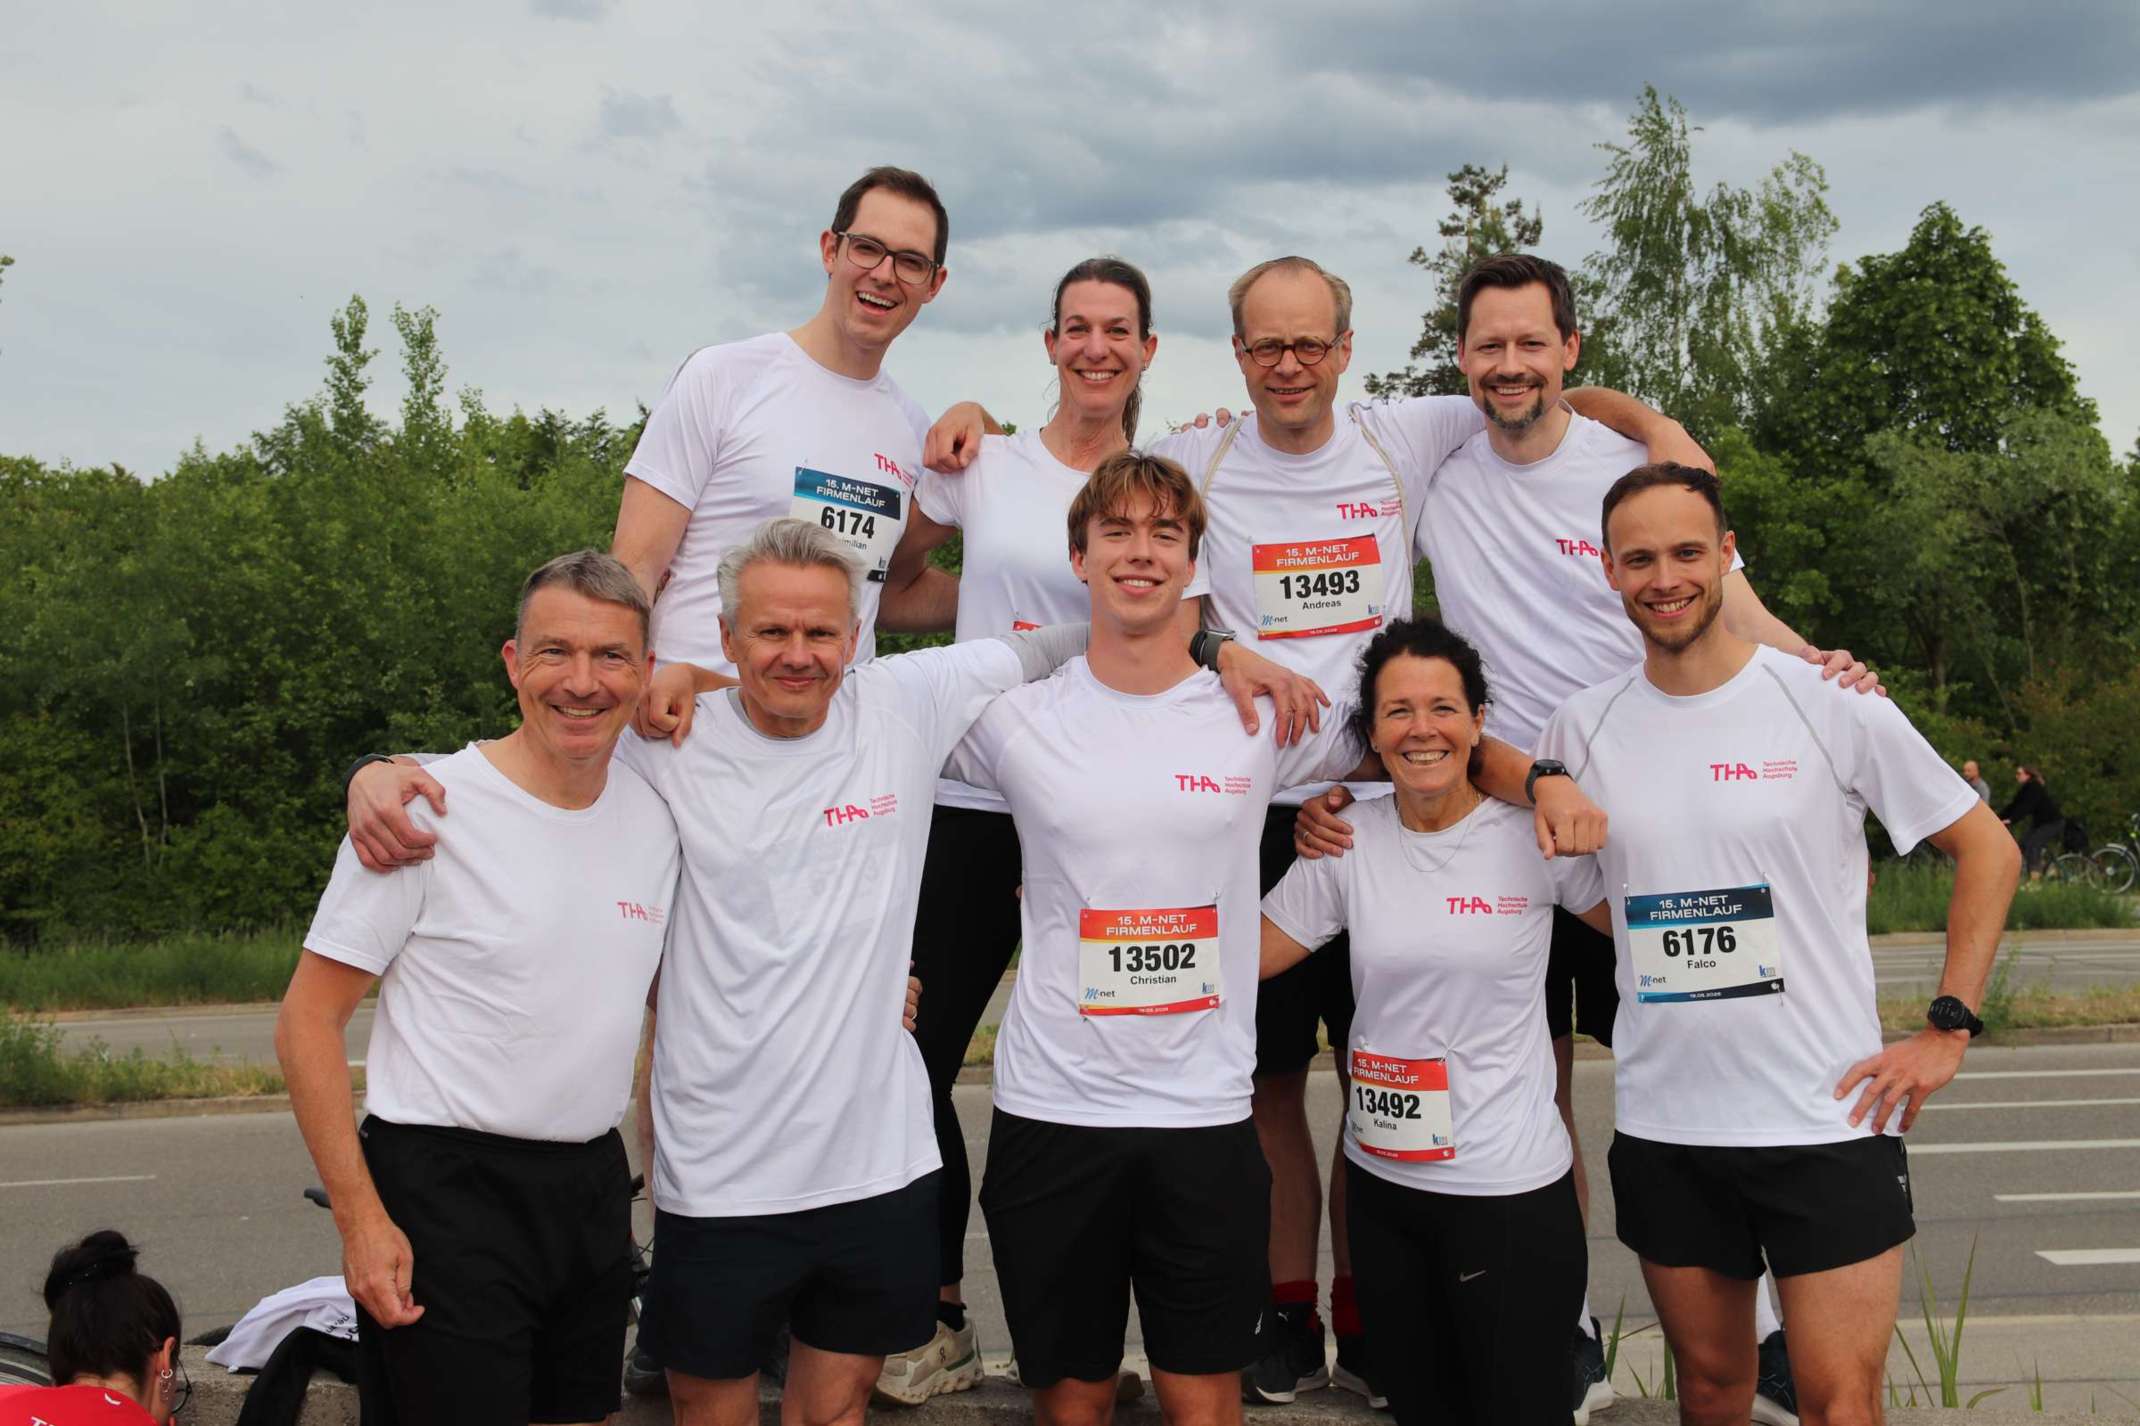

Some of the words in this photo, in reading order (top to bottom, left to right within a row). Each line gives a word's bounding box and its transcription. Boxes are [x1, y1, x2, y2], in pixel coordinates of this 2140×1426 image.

[816, 486, 886, 508] FIRMENLAUF
[826, 479, 839, 490] 15.
[842, 482, 879, 497] M-NET
[1336, 502, 1377, 520] THA
[821, 506, 875, 539] 6174
[1286, 548, 1302, 557] 15.
[1306, 544, 1349, 556] M-NET
[1555, 539, 1599, 557] THA
[1276, 552, 1360, 567] FIRMENLAUF
[1279, 570, 1360, 600] 13493
[1302, 600, 1342, 611] Andreas
[1710, 763, 1758, 781] THA
[1175, 774, 1221, 793] THA
[824, 804, 869, 827] THA
[1446, 896, 1492, 914] THA
[1659, 899, 1677, 909] 15.
[1681, 895, 1728, 907] M-NET
[1118, 916, 1136, 925] 15.
[1140, 914, 1187, 924] M-NET
[1650, 904, 1743, 921] FIRMENLAUF
[1106, 924, 1197, 936] FIRMENLAUF
[1662, 926, 1737, 957] 6176
[1108, 943, 1196, 972] 13502
[1687, 959, 1717, 969] Falco
[1130, 975, 1177, 985] Christian
[1358, 1058, 1370, 1069] 15.
[1371, 1060, 1407, 1073] M-NET
[1353, 1066, 1419, 1084] FIRMENLAUF
[1356, 1086, 1422, 1119] 13492
[1373, 1118, 1397, 1131] Kalina
